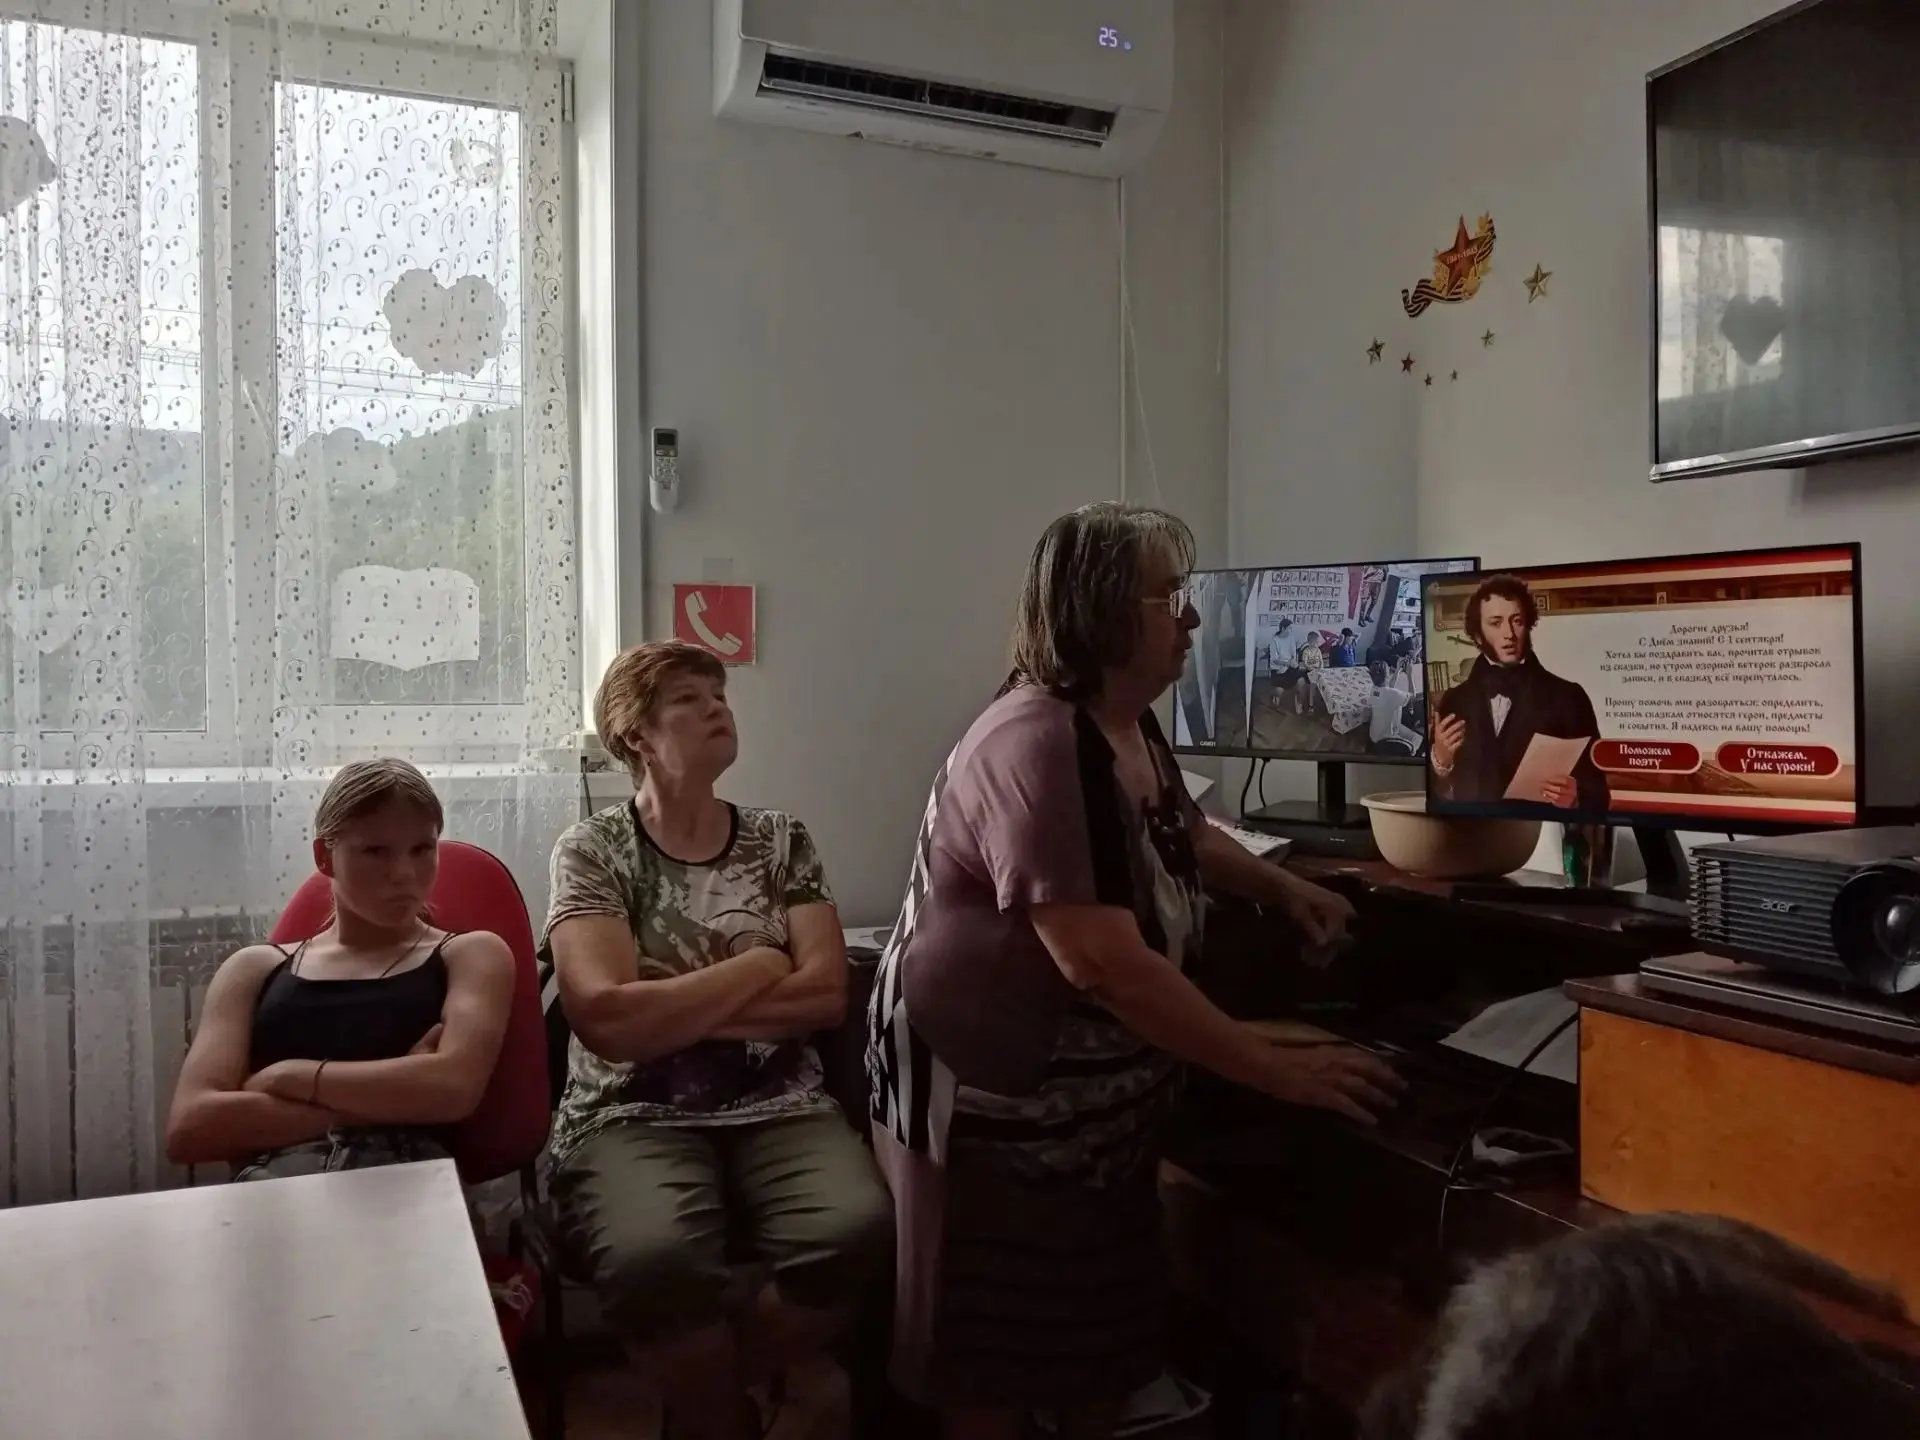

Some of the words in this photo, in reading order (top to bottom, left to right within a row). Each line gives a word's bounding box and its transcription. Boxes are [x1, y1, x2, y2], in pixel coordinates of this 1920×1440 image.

[1099, 26, 1118, 47] 25
[1669, 624, 1708, 635] Дорогие
[1711, 622, 1749, 634] друзья!
[1638, 637, 1646, 647] С
[1649, 636, 1674, 648] Днём
[1676, 636, 1715, 646] знаний!
[1717, 635, 1725, 644] С
[1728, 635, 1733, 644] 1
[1735, 633, 1784, 646] сентября!
[1605, 650, 1631, 659] Хотел
[1634, 651, 1646, 659] бы
[1649, 650, 1704, 660] поздравить
[1707, 650, 1725, 658] вас,
[1728, 649, 1774, 658] прочитав
[1777, 648, 1821, 658] отрывок
[1613, 663, 1647, 671] сказки,
[1663, 663, 1693, 672] утром
[1695, 661, 1735, 671] озорной
[1737, 662, 1776, 671] ветерок
[1779, 660, 1831, 671] разбросал
[1622, 675, 1656, 683] записи,
[1675, 675, 1713, 684] сказках
[1605, 697, 1635, 708] Прошу
[1761, 699, 1824, 710] определить,
[1645, 711, 1683, 719] сказкам
[1686, 712, 1736, 720] относятся
[1739, 712, 1768, 721] герои,
[1771, 712, 1823, 722] предметы
[1628, 722, 1668, 731] события.
[1671, 721, 1678, 731] Я
[1681, 723, 1719, 732] надеюсь
[1735, 724, 1762, 734] вашу
[1765, 723, 1810, 734] помощь!
[1619, 743, 1672, 756] Поможем
[1747, 747, 1807, 760] Откажем.
[1628, 757, 1662, 770] поэту
[1740, 758, 1750, 773] У
[1753, 761, 1772, 771] нас
[1776, 761, 1815, 775] уроки!
[1760, 900, 1794, 913] acer
